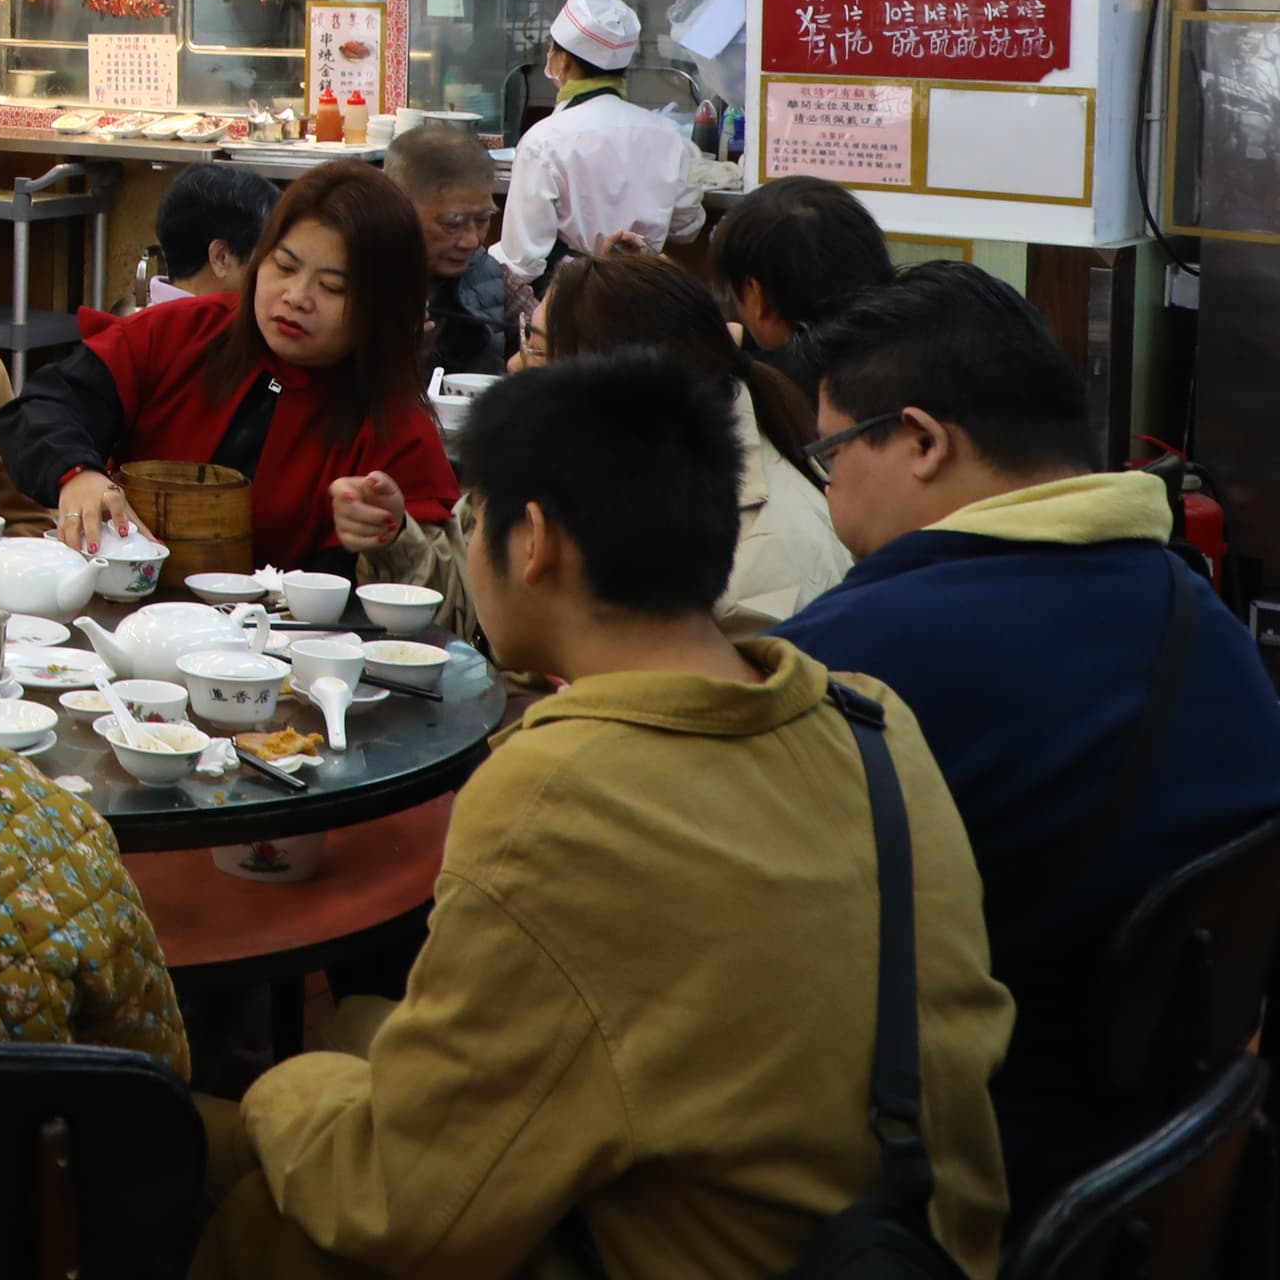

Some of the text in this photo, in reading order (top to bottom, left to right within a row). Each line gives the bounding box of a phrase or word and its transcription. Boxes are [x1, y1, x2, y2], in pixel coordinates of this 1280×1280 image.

[787, 100, 891, 112] 離開坐位及取點
